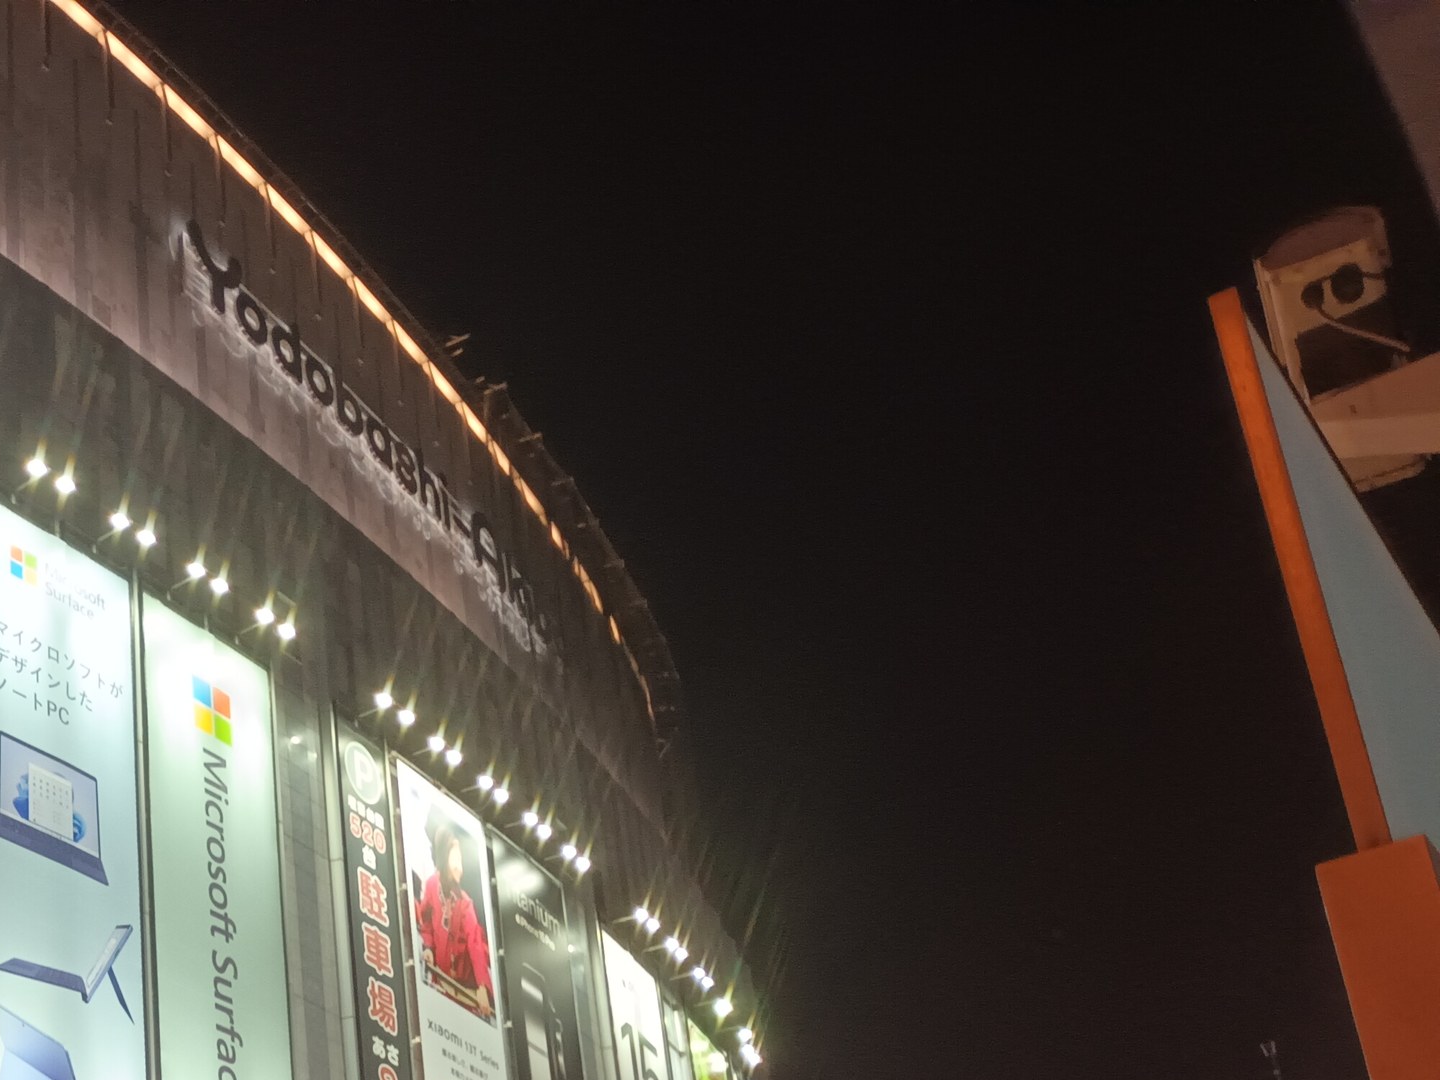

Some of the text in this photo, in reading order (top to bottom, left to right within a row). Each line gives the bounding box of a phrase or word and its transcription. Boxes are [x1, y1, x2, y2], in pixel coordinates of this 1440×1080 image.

[186, 218, 549, 656] Yodobashi-Ak
[43, 581, 97, 621] Surface
[203, 746, 240, 949] Microsoft
[348, 811, 387, 855] 520
[356, 865, 398, 1037] 駐車場
[371, 1035, 400, 1067] あさ
